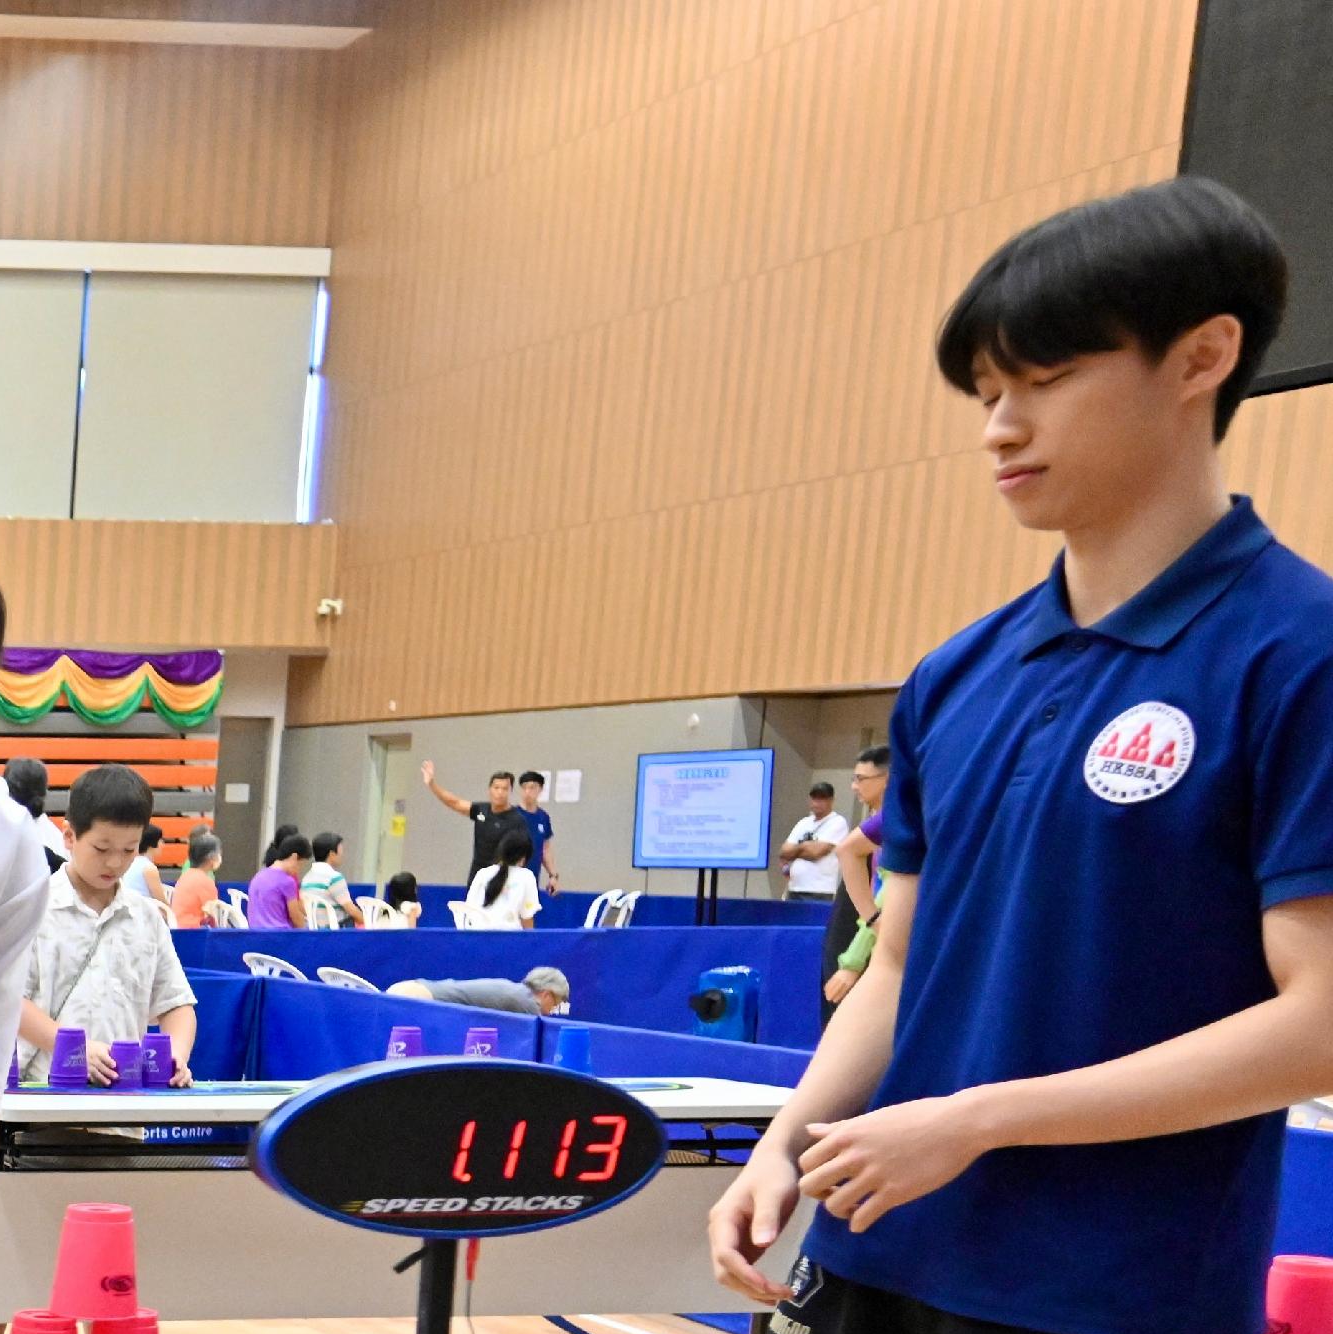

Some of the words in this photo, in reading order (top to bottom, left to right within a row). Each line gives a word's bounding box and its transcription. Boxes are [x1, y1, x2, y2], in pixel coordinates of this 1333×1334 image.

[1099, 760, 1157, 782] HKSSA
[171, 1126, 213, 1139] Centre
[361, 1198, 467, 1214] SPEED
[469, 1194, 584, 1212] STACKS
